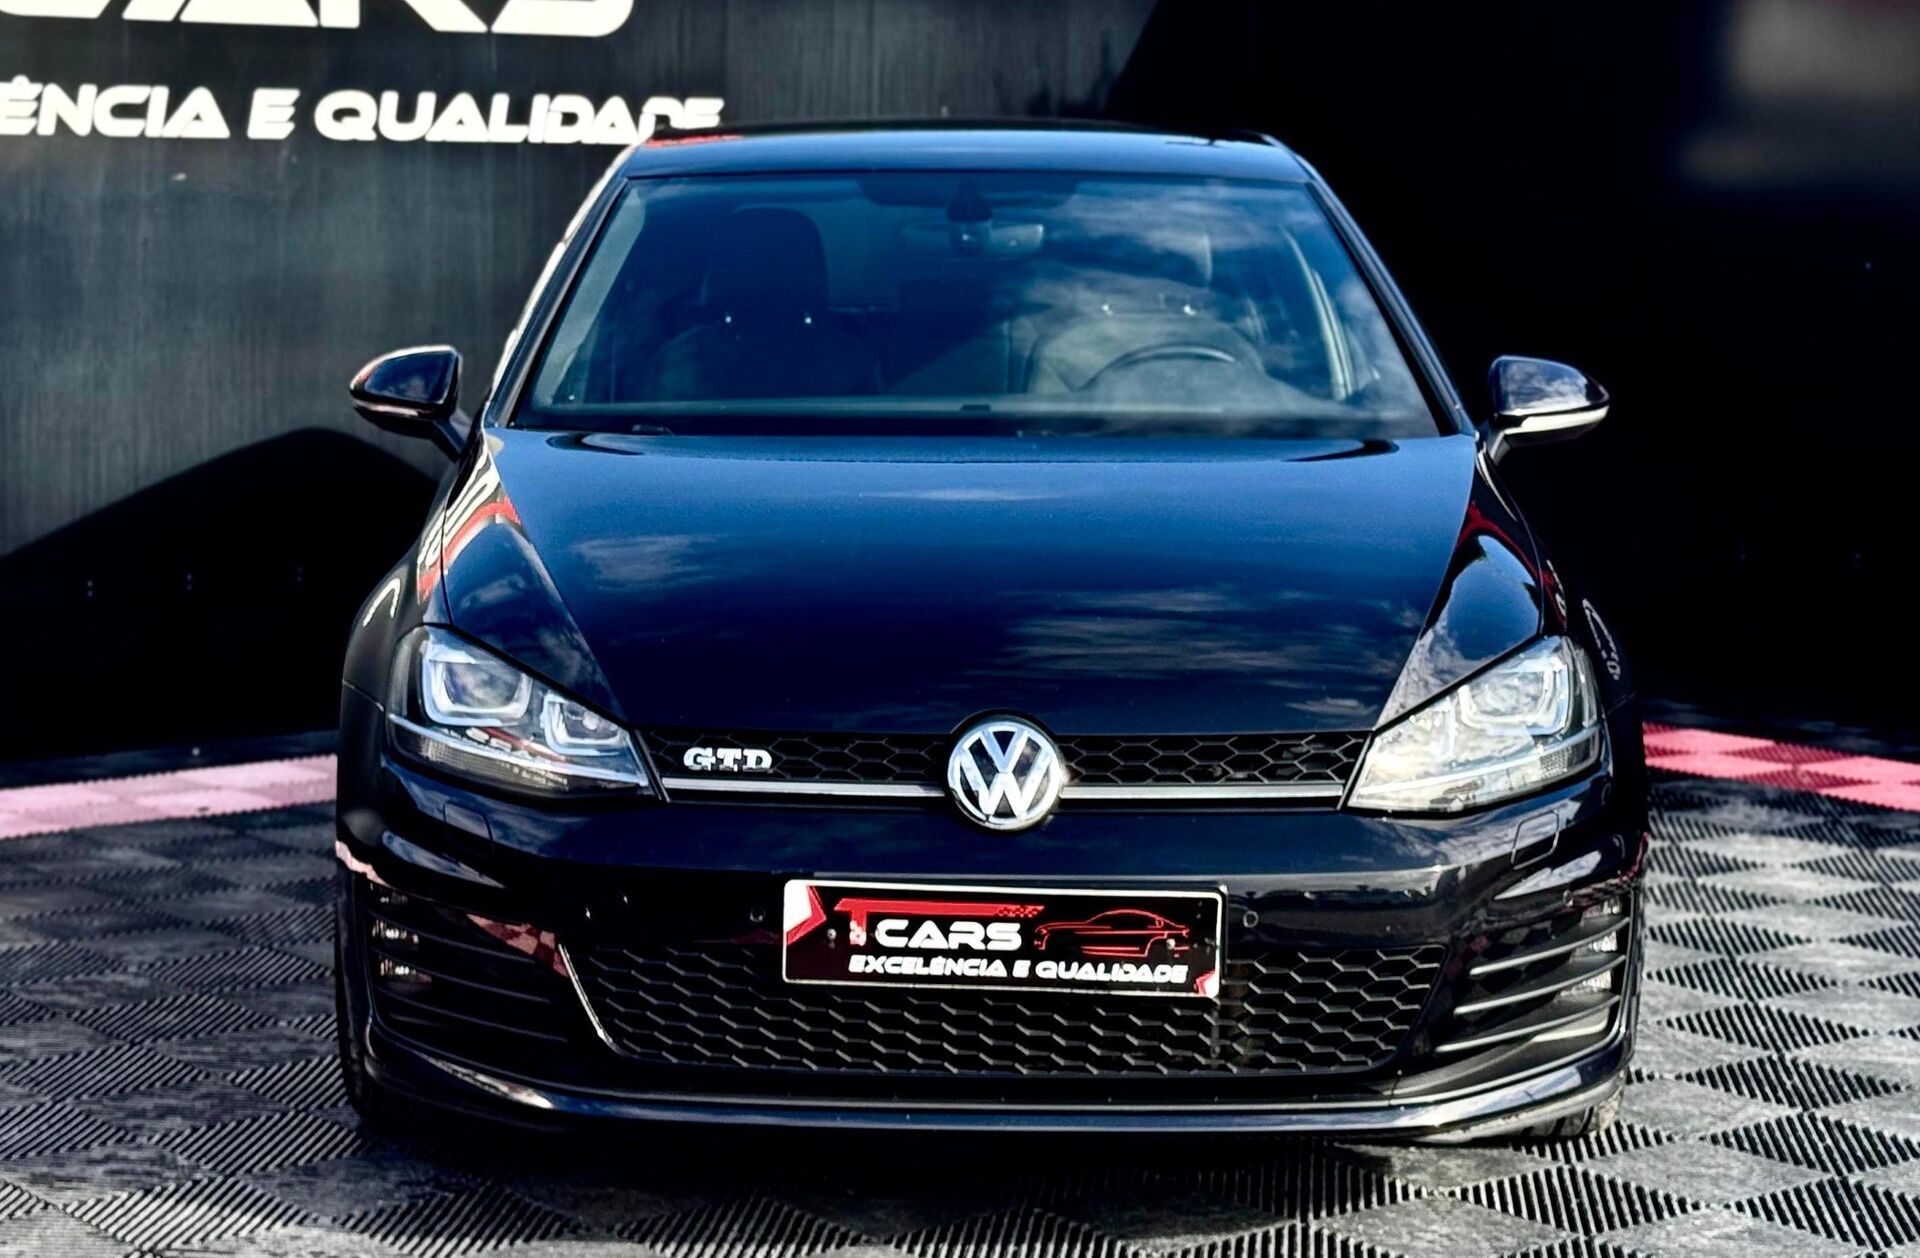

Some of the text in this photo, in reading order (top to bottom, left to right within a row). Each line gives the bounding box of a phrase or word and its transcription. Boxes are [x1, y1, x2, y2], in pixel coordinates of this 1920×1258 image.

[247, 88, 301, 140] E
[683, 747, 773, 772] GTD
[875, 919, 1022, 951] CARS
[1012, 959, 1032, 978] E
[1035, 960, 1188, 984] QUALIDADE
